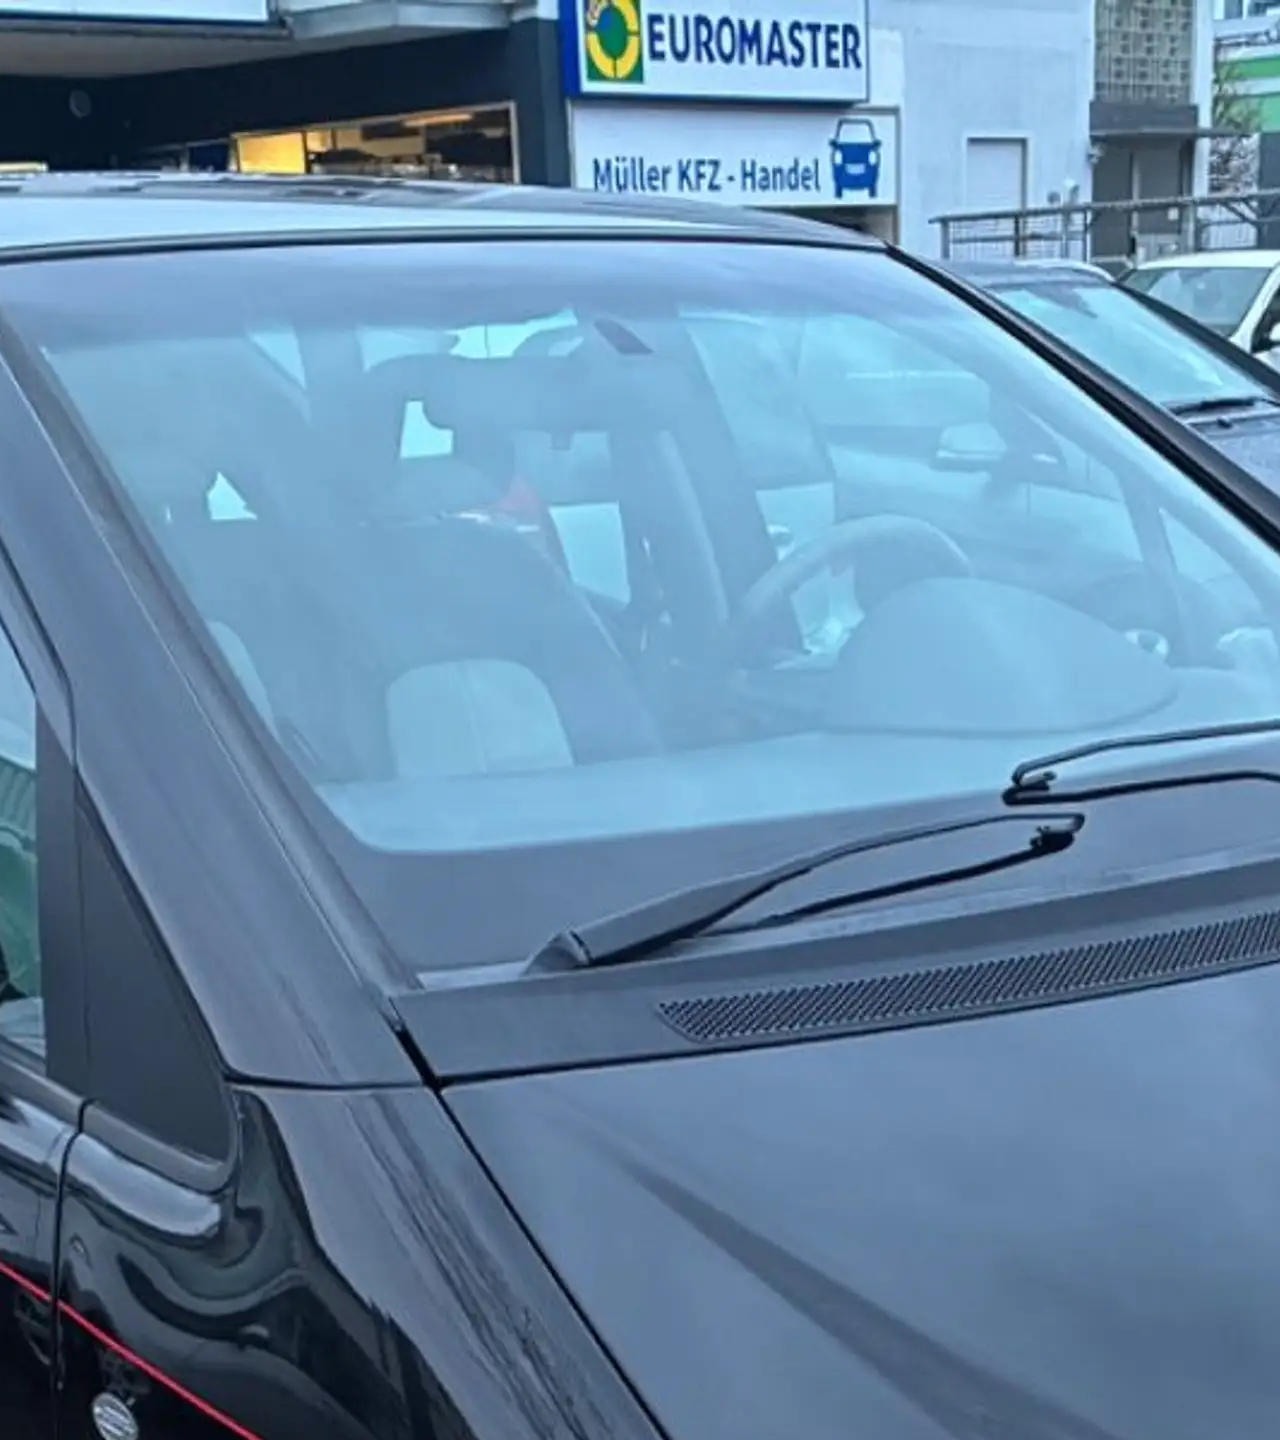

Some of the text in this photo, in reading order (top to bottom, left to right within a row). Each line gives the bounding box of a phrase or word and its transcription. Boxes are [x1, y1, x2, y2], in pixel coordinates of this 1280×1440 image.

[647, 13, 863, 69] EUROMASTER
[593, 156, 671, 192] Müller
[677, 158, 721, 192] KFZ
[740, 158, 821, 192] Handel
